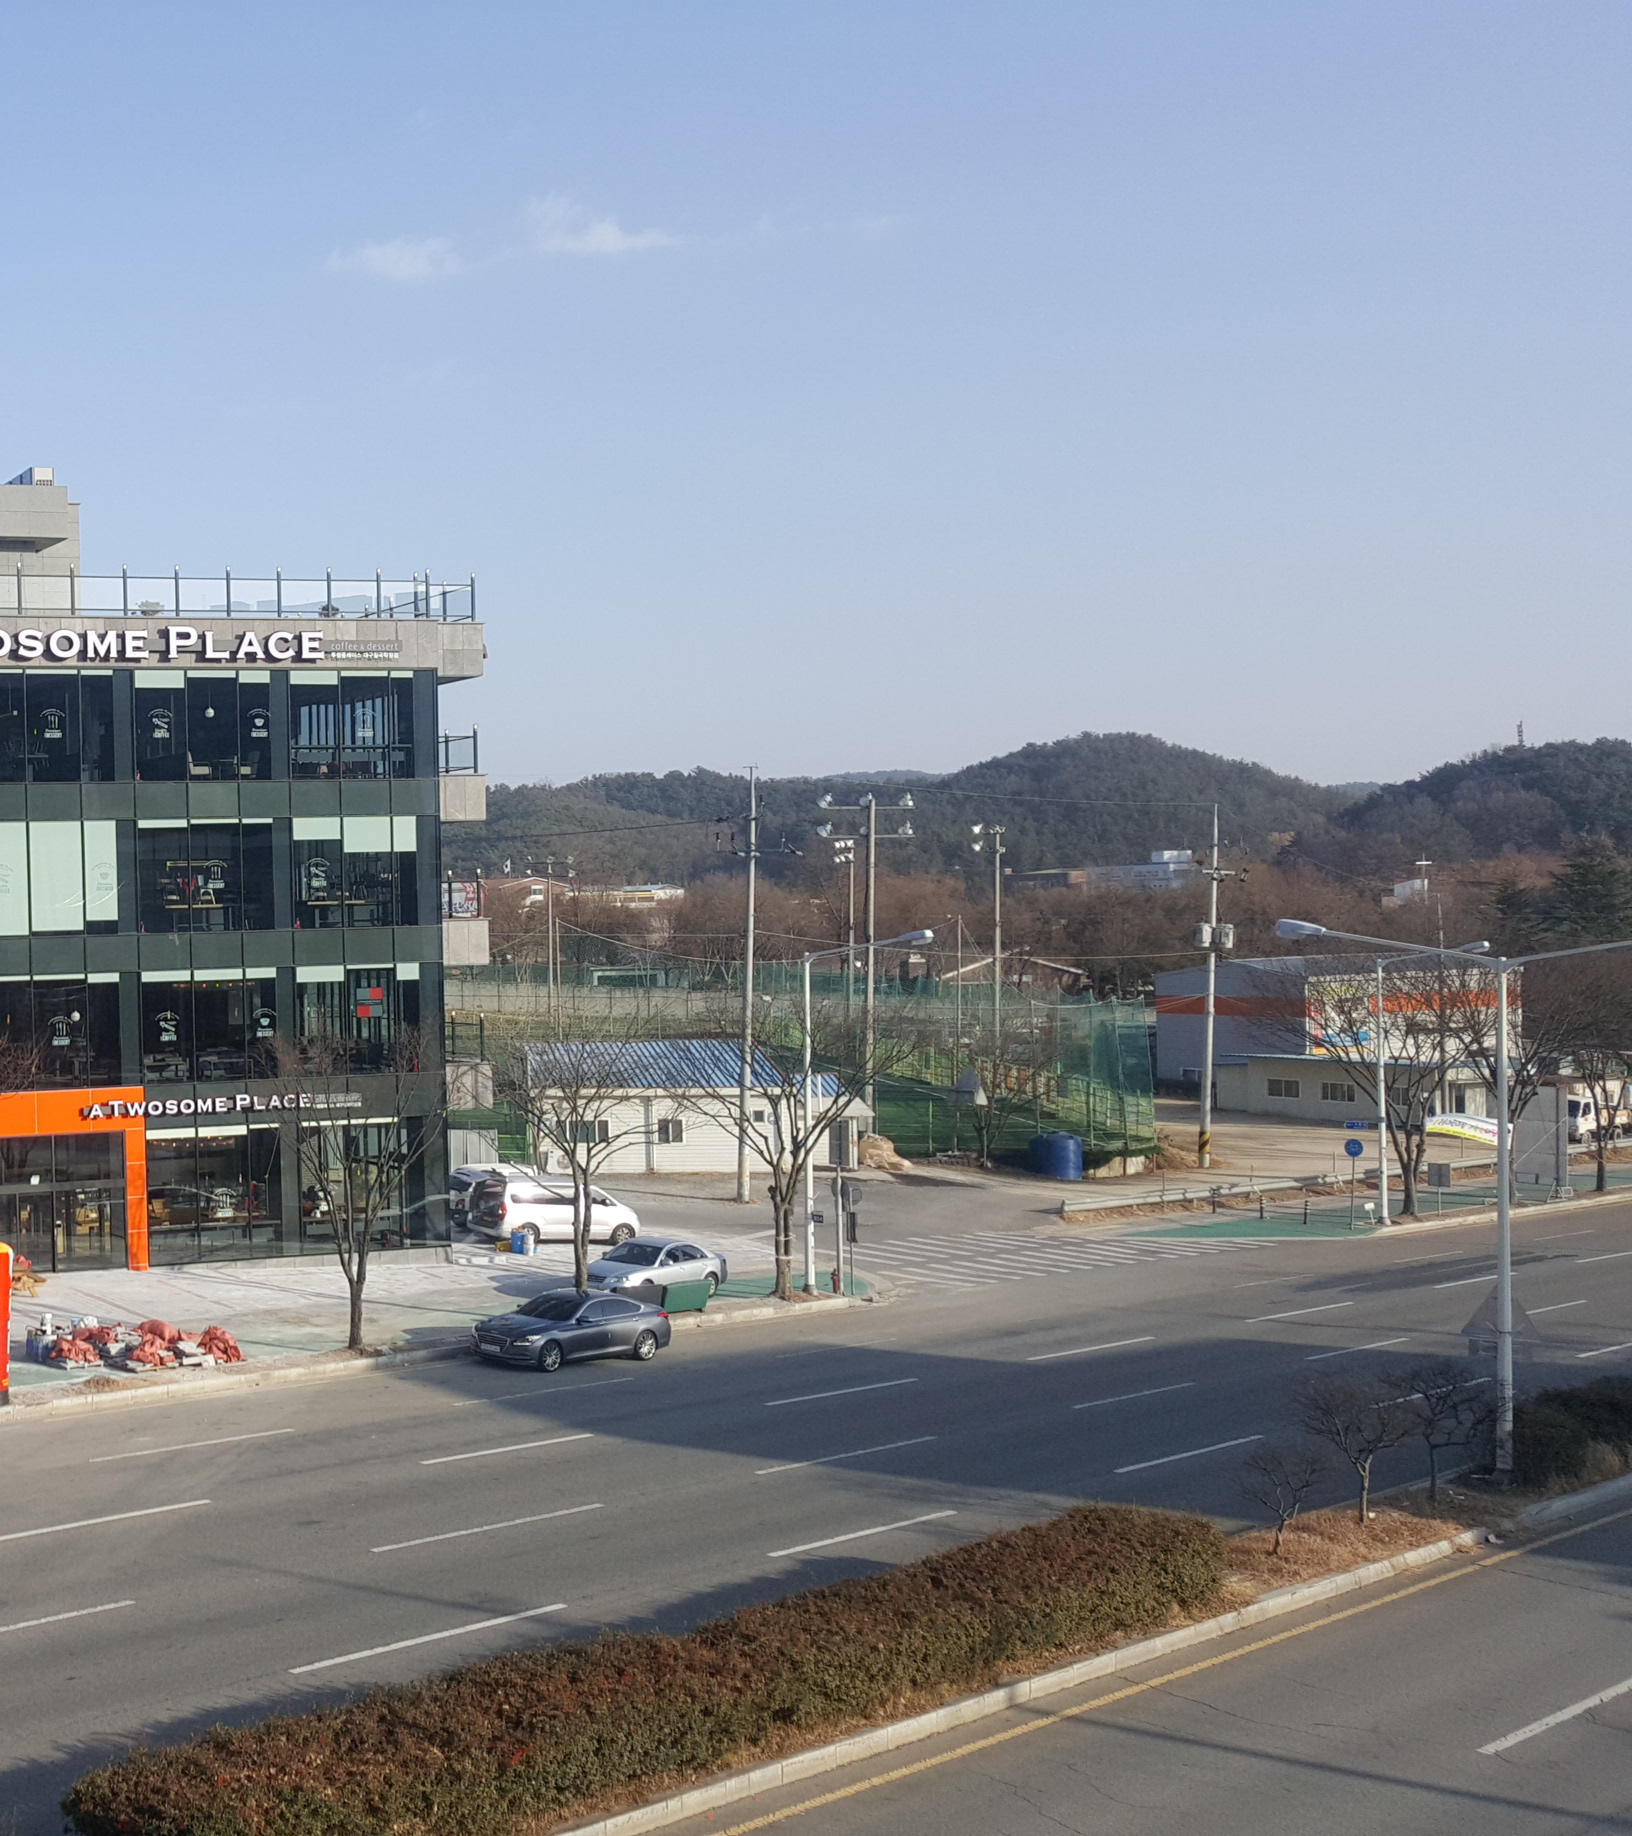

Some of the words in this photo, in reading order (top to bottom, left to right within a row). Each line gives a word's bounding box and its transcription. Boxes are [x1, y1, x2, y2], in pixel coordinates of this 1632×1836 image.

[166, 625, 325, 659] PLACE
[330, 641, 358, 651] coffee
[366, 641, 398, 651] dessert
[89, 1104, 104, 1119] A
[108, 1097, 228, 1118] TWOSOME
[235, 1093, 311, 1111] PLACE
